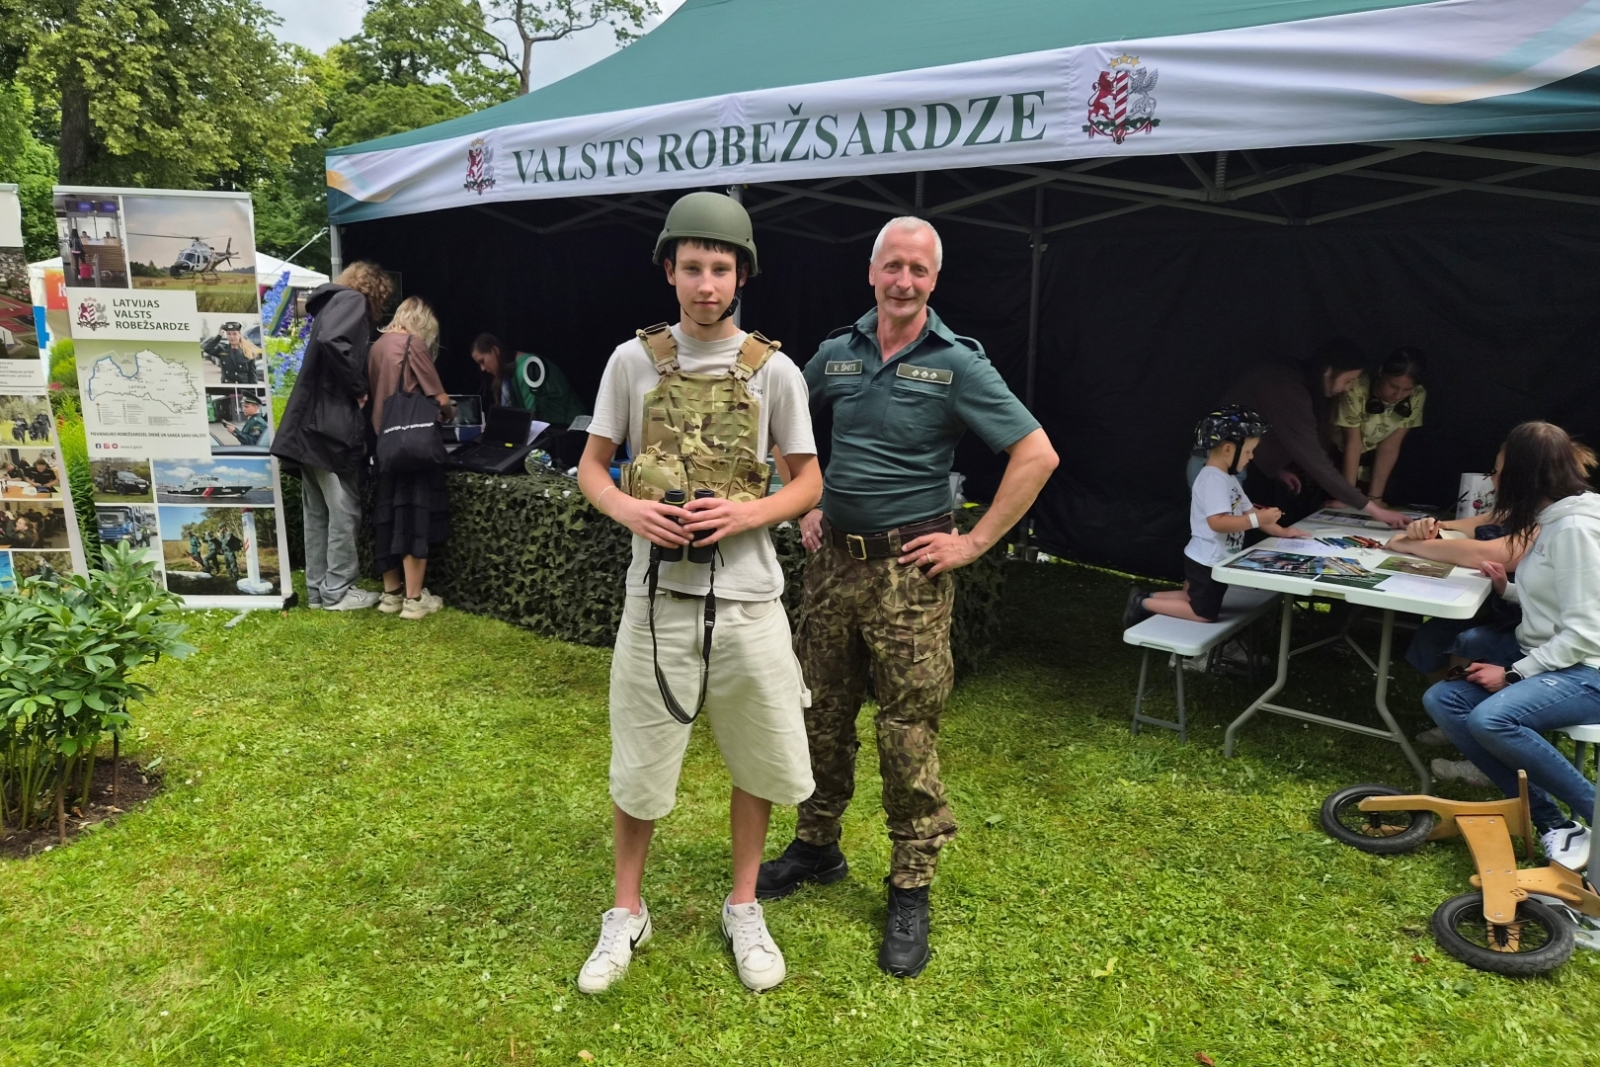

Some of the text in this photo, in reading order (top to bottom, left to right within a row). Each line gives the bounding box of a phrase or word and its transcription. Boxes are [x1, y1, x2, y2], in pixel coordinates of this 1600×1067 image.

[511, 91, 1047, 185] VALSTS ROBEŽSARDZE
[112, 298, 160, 308] LATVIJAS
[113, 309, 152, 319] VALSTS
[115, 320, 190, 331] ROBEŽSARDZE
